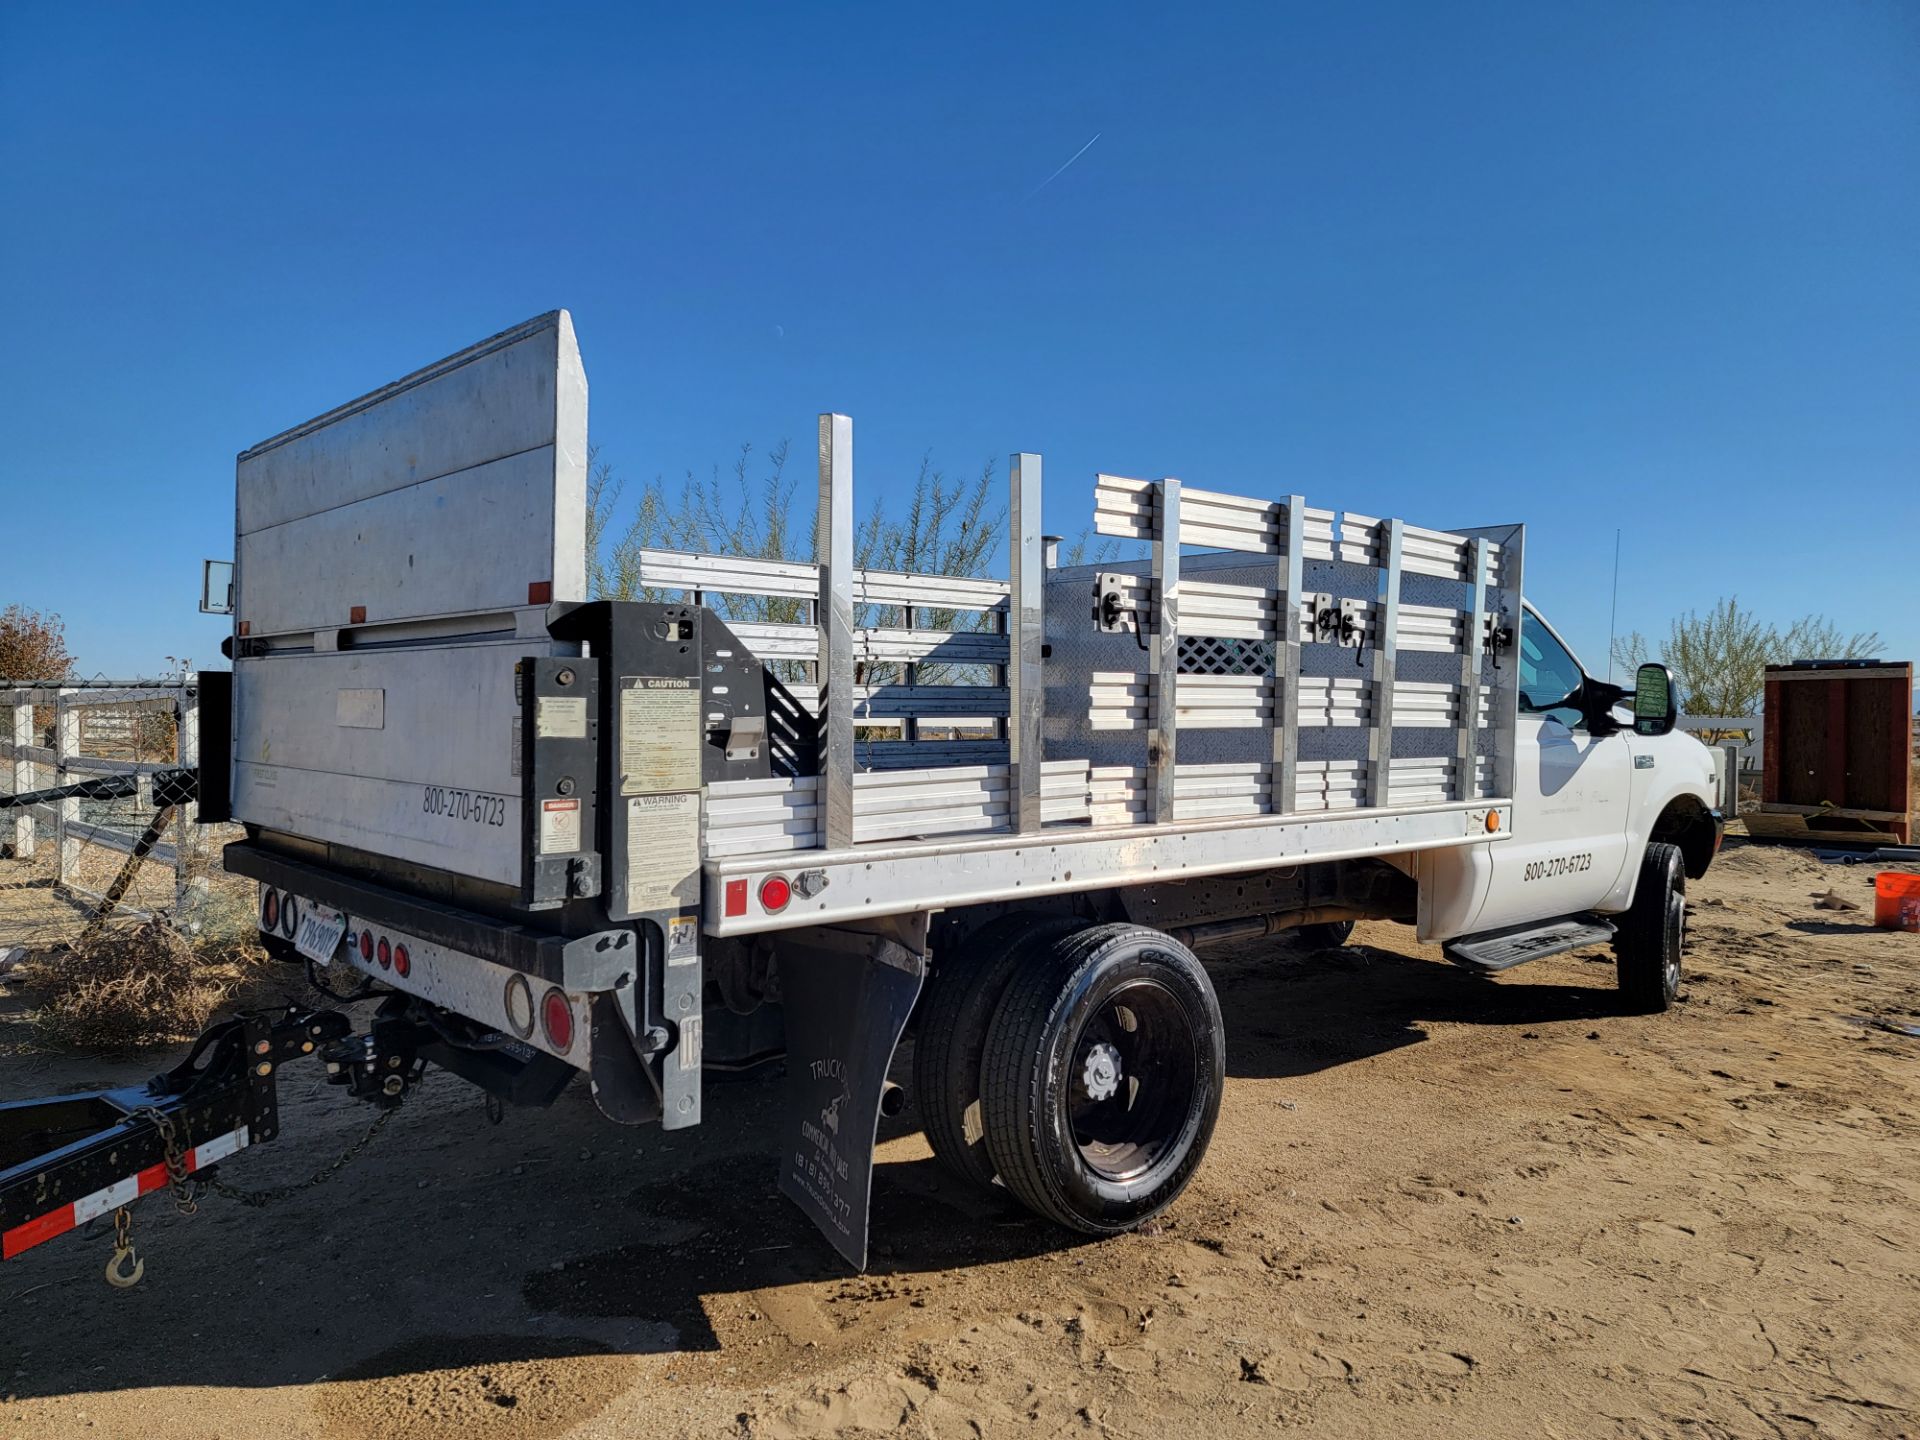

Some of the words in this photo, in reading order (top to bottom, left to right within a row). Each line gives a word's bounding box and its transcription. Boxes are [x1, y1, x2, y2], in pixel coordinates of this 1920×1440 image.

[647, 680, 690, 688] CAUTION
[423, 787, 505, 827] 800-270-6723
[643, 795, 688, 806] WARNING
[1524, 853, 1592, 881] 800-270-6723
[810, 1059, 841, 1080] TRUCK
[795, 1151, 816, 1178] (818)
